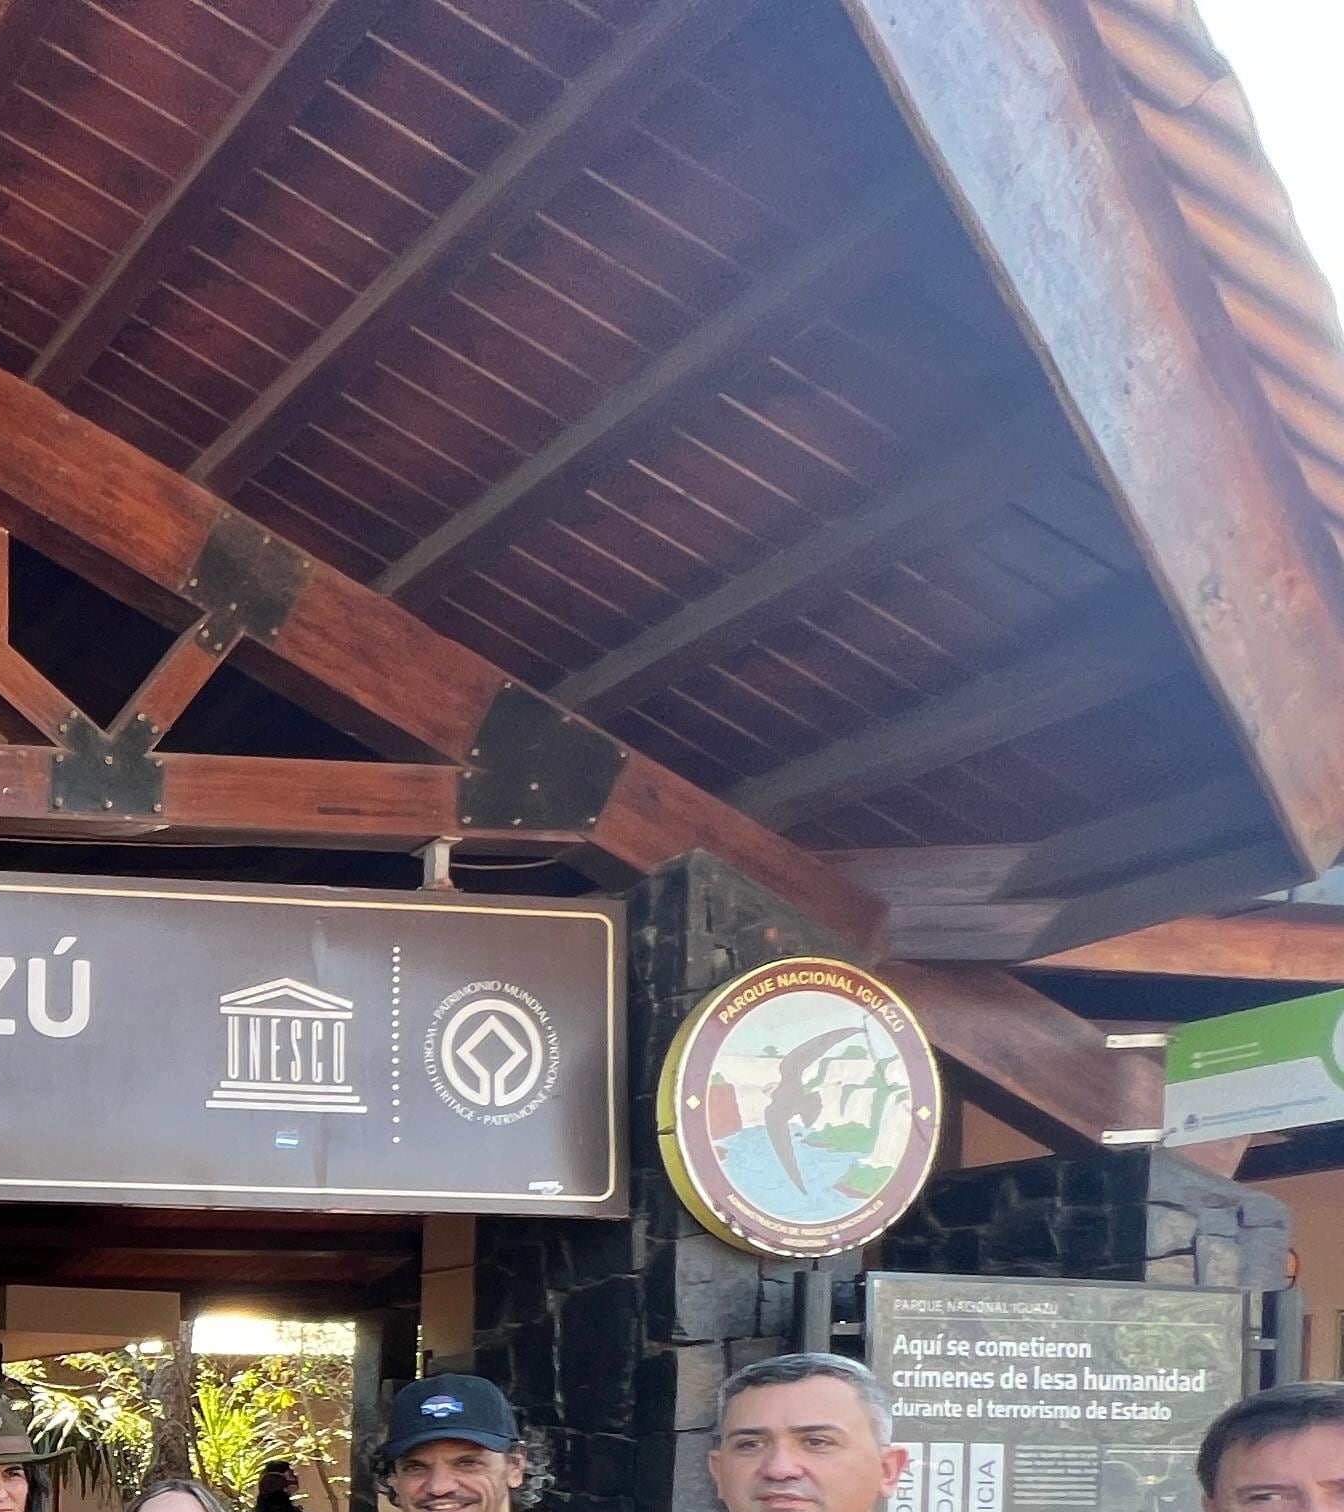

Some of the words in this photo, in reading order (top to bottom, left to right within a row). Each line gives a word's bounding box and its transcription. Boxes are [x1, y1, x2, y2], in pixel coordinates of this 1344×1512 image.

[503, 983, 551, 1026] MUNDIAL
[719, 978, 776, 1025] PARQUE
[777, 971, 854, 994] NACIONAL
[227, 1015, 346, 1084] UNESCO
[893, 1299, 944, 1312] PARQUE
[946, 1300, 1009, 1314] NACIONAL
[892, 1334, 944, 1361] Aquí
[946, 1339, 971, 1356] se
[974, 1336, 1092, 1359] cometieron
[892, 1364, 994, 1389] crímenes
[999, 1366, 1029, 1390] de
[1032, 1366, 1078, 1392] lesa
[1082, 1367, 1206, 1394] humanidad
[892, 1397, 963, 1419] durante
[966, 1397, 983, 1419] el
[986, 1398, 1081, 1421] terrorismo
[1085, 1400, 1108, 1421] de
[1111, 1401, 1172, 1421] Estado
